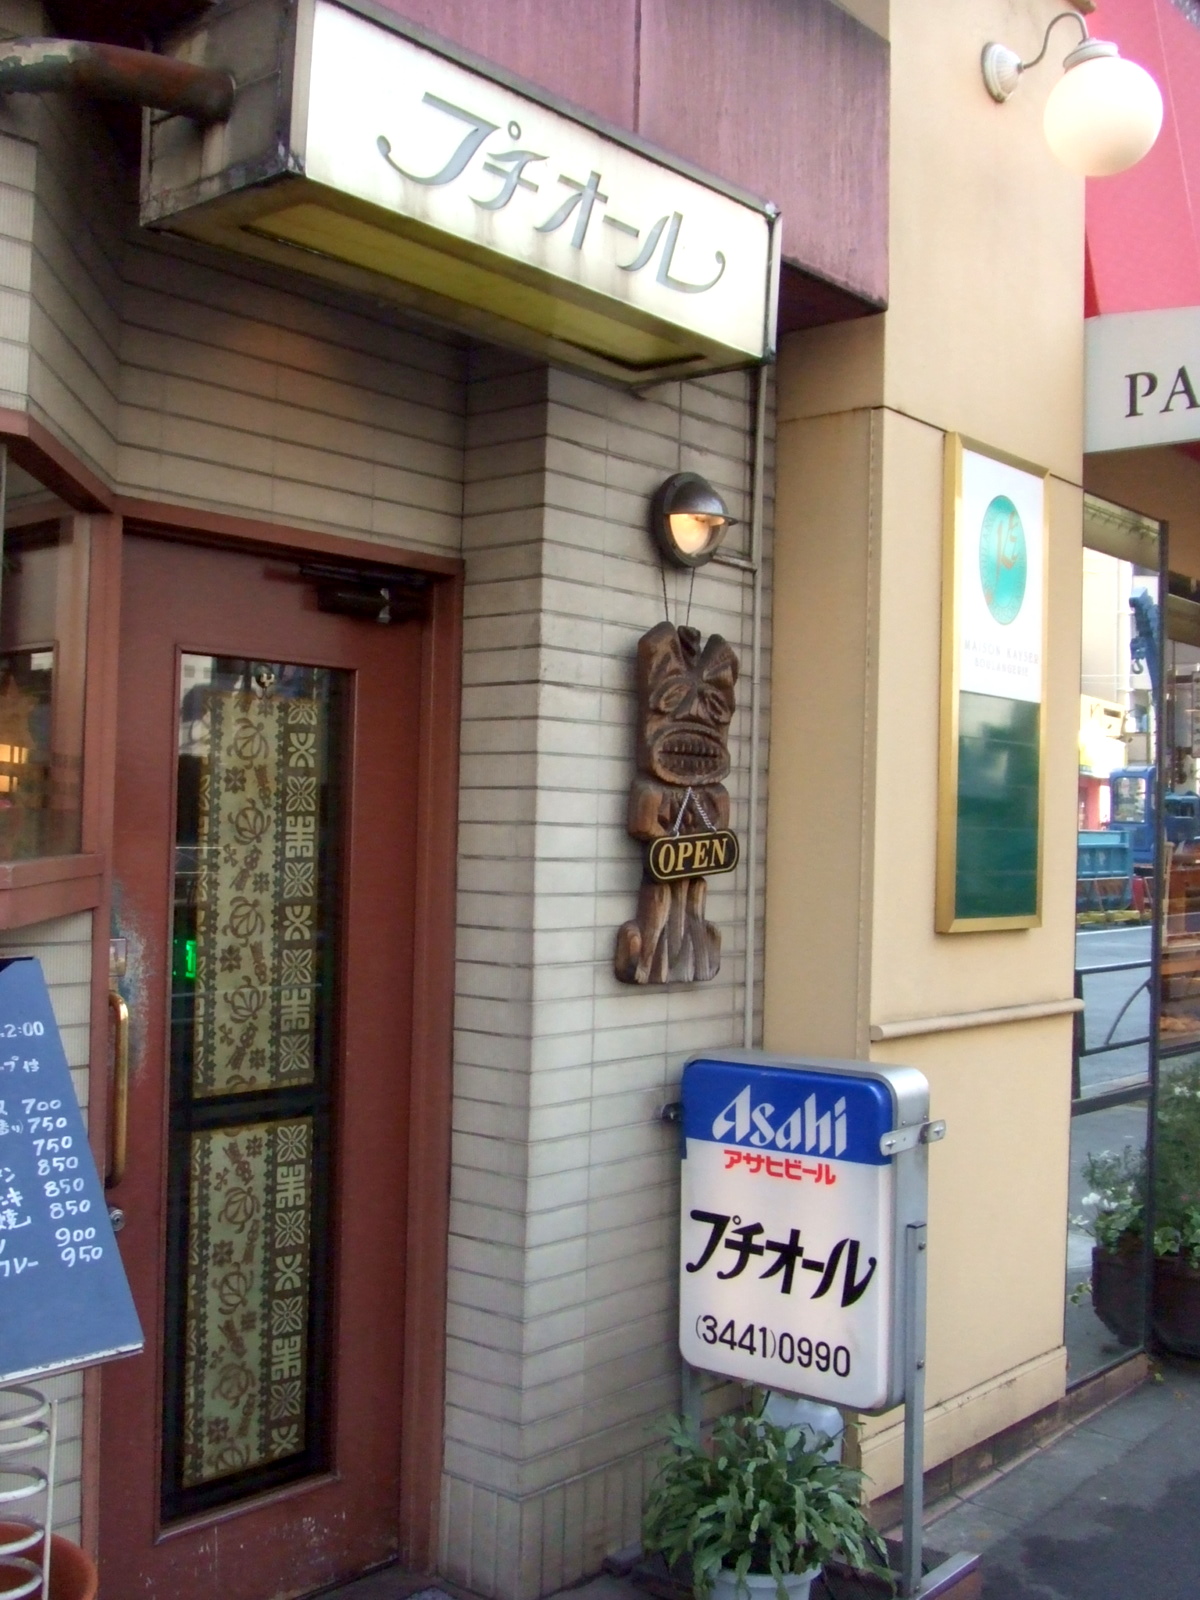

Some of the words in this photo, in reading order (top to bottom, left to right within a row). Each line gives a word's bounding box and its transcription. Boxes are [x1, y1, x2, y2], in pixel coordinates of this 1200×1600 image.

[376, 91, 726, 294] プチオール
[658, 838, 728, 874] OPEN
[22, 1098, 61, 1114] 700
[28, 1117, 67, 1134] 750
[711, 1084, 848, 1157] Asahi
[33, 1136, 72, 1156] 750
[38, 1156, 78, 1176] 850
[724, 1149, 837, 1185] アサヒビール
[44, 1177, 84, 1197] 850
[50, 1199, 91, 1219] 850
[55, 1227, 96, 1247] 900
[61, 1245, 103, 1267] 950
[686, 1209, 877, 1308] プチオール
[696, 1314, 851, 1378] (3441)0990
